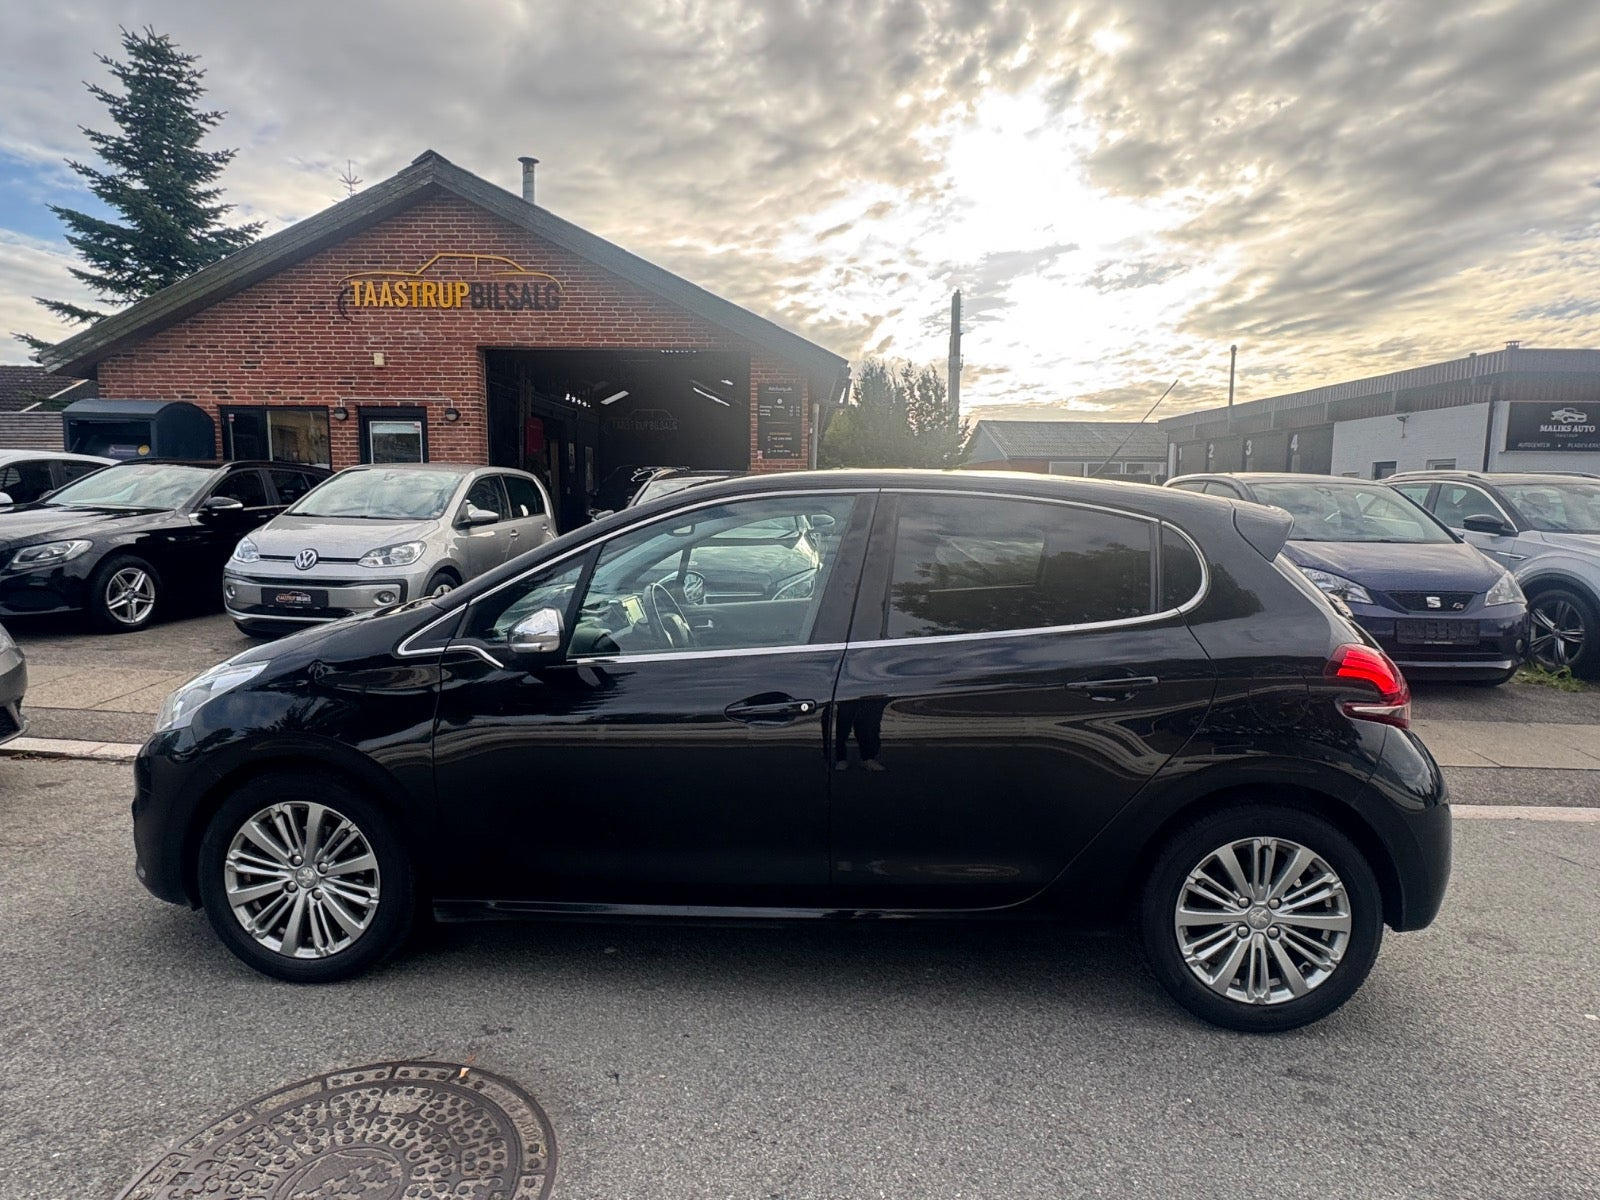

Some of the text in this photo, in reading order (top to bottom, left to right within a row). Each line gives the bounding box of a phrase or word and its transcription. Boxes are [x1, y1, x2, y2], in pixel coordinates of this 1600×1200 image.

[1245, 440, 1252, 455] 3
[1290, 434, 1298, 451] 4
[1179, 447, 1182, 460] 1
[1208, 444, 1214, 458] 2
